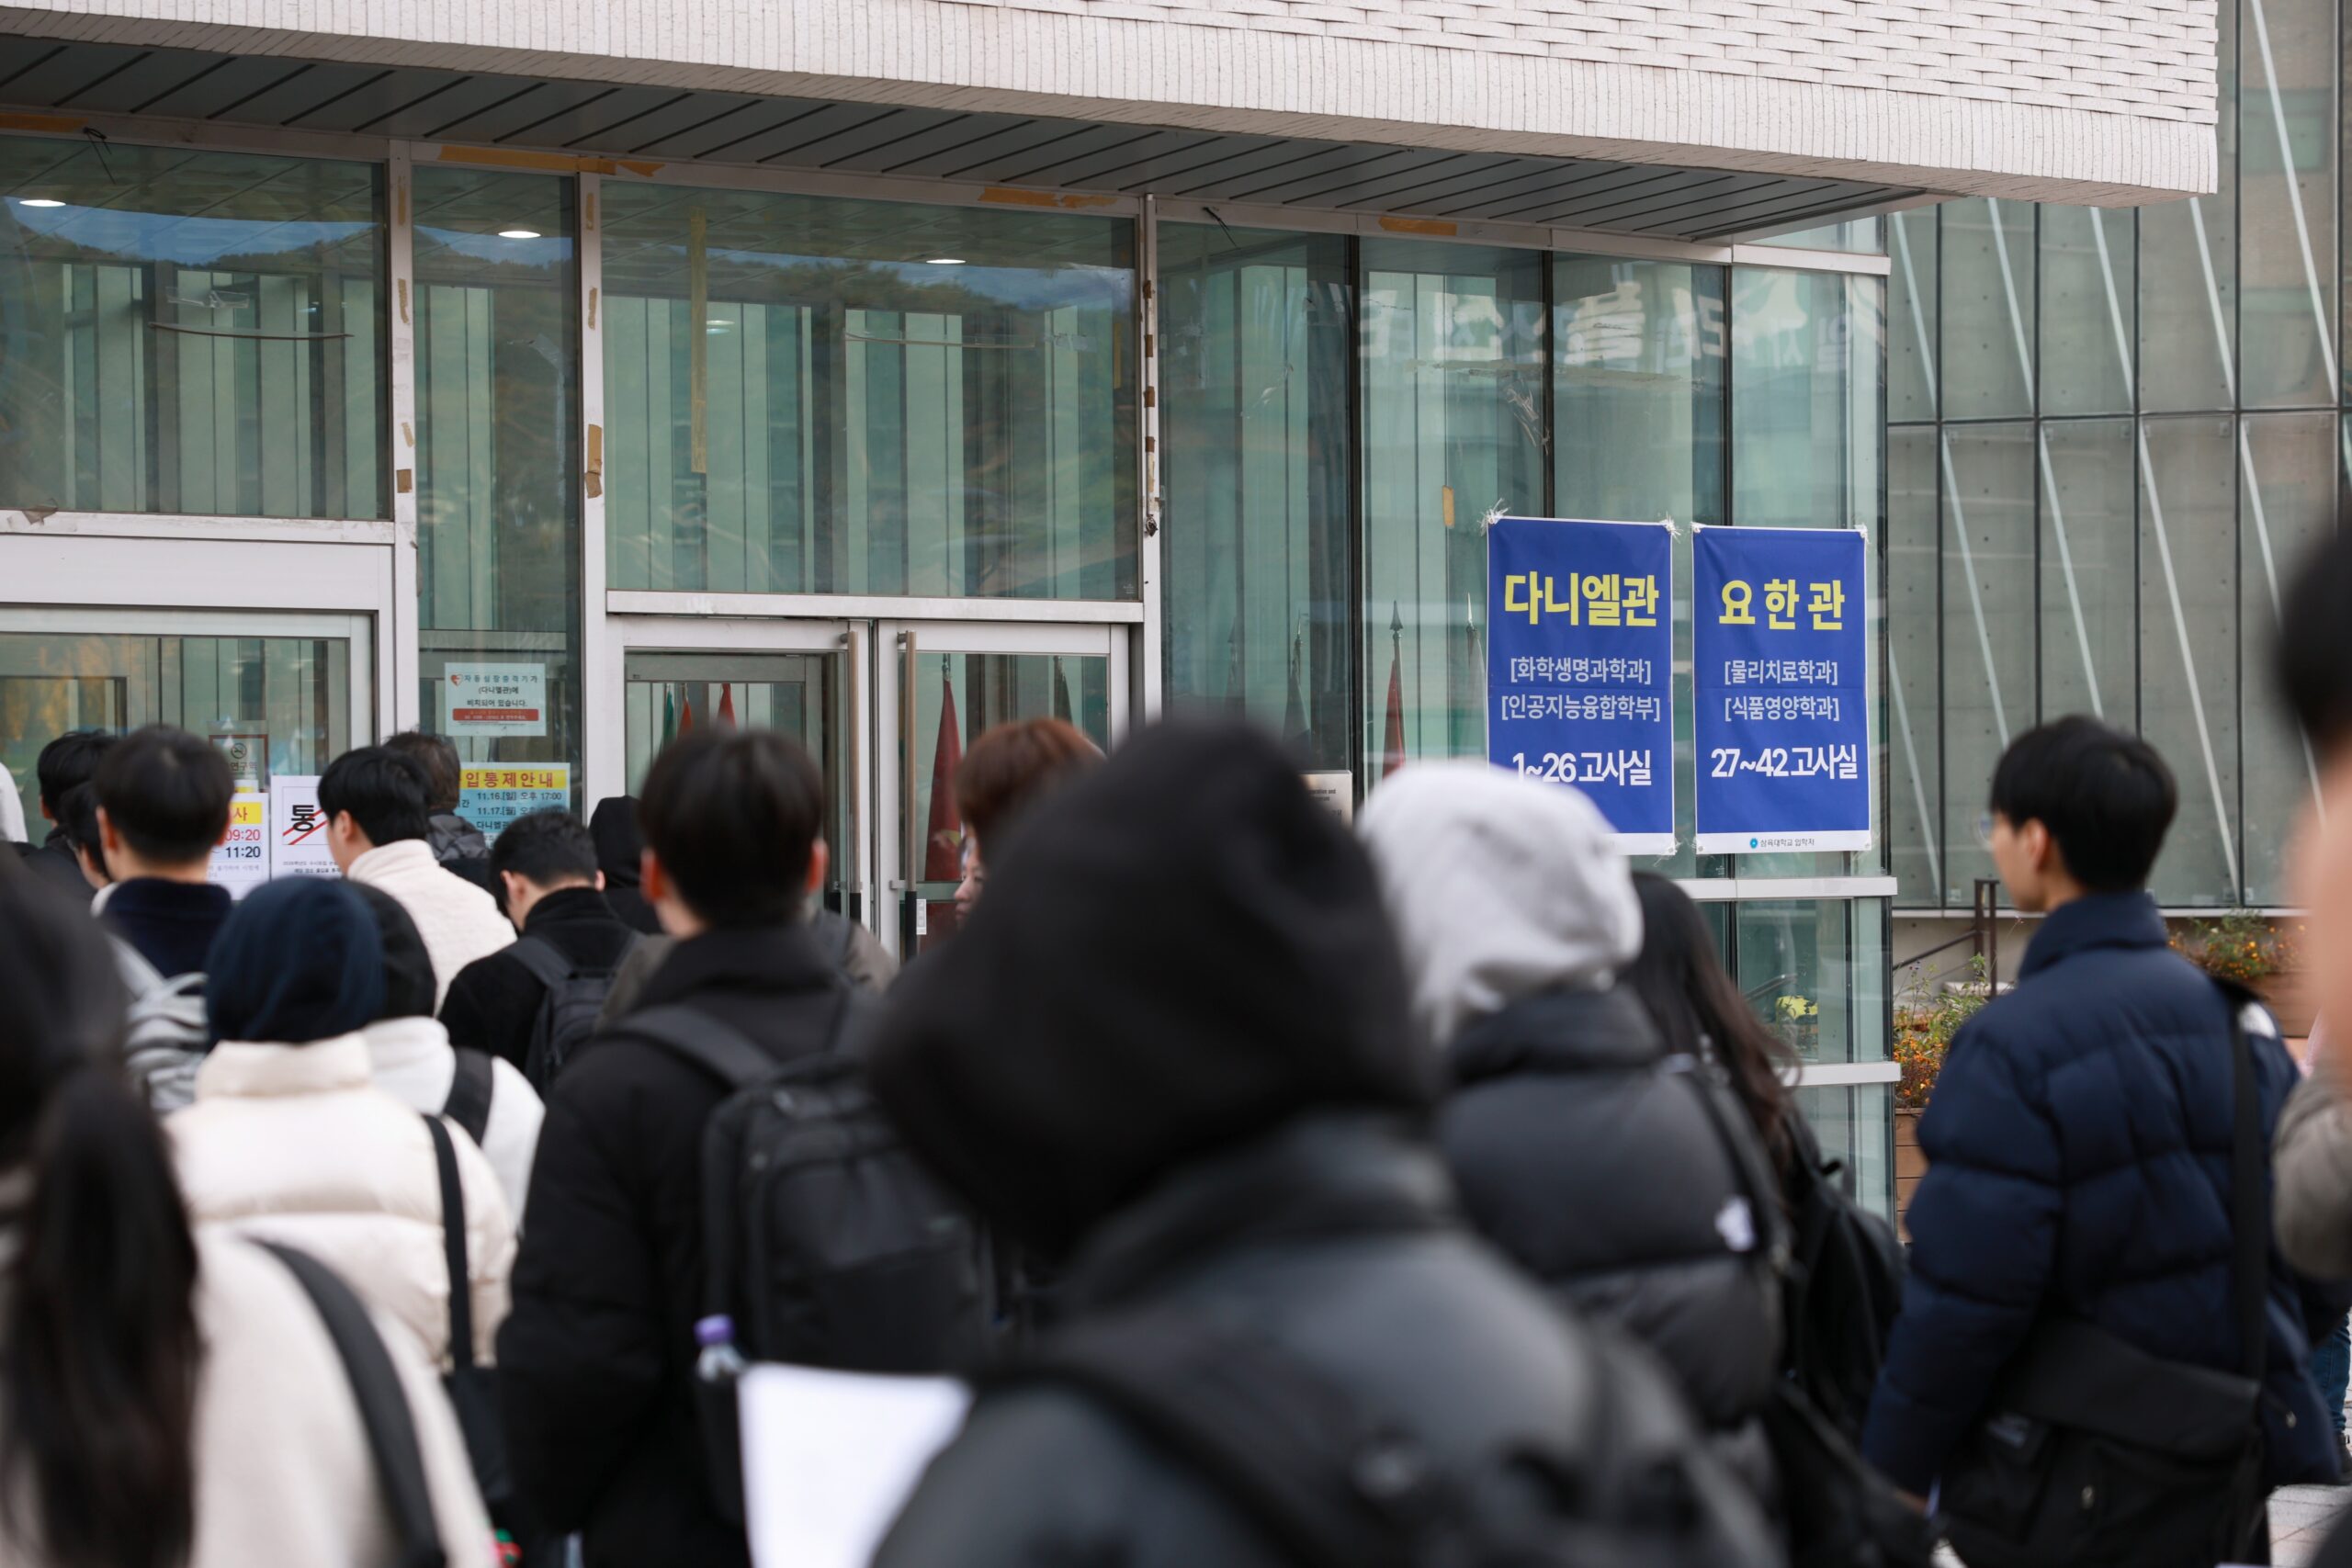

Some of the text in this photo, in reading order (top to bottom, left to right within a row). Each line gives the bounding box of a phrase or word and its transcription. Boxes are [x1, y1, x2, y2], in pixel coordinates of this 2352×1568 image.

[1504, 570, 1660, 627] 다니엘관
[1510, 656, 1652, 685] [화학생명과학과]
[1724, 660, 1838, 685] [물리치료학과]
[1501, 694, 1661, 722] [인공지능융합학부]
[1724, 696, 1840, 723] [식품영양학과]
[230, 761, 257, 771] 연구역
[461, 772, 555, 789] 입통제안내
[290, 805, 315, 832] 통
[225, 829, 261, 841] 09:20
[225, 846, 262, 858] 11:20
